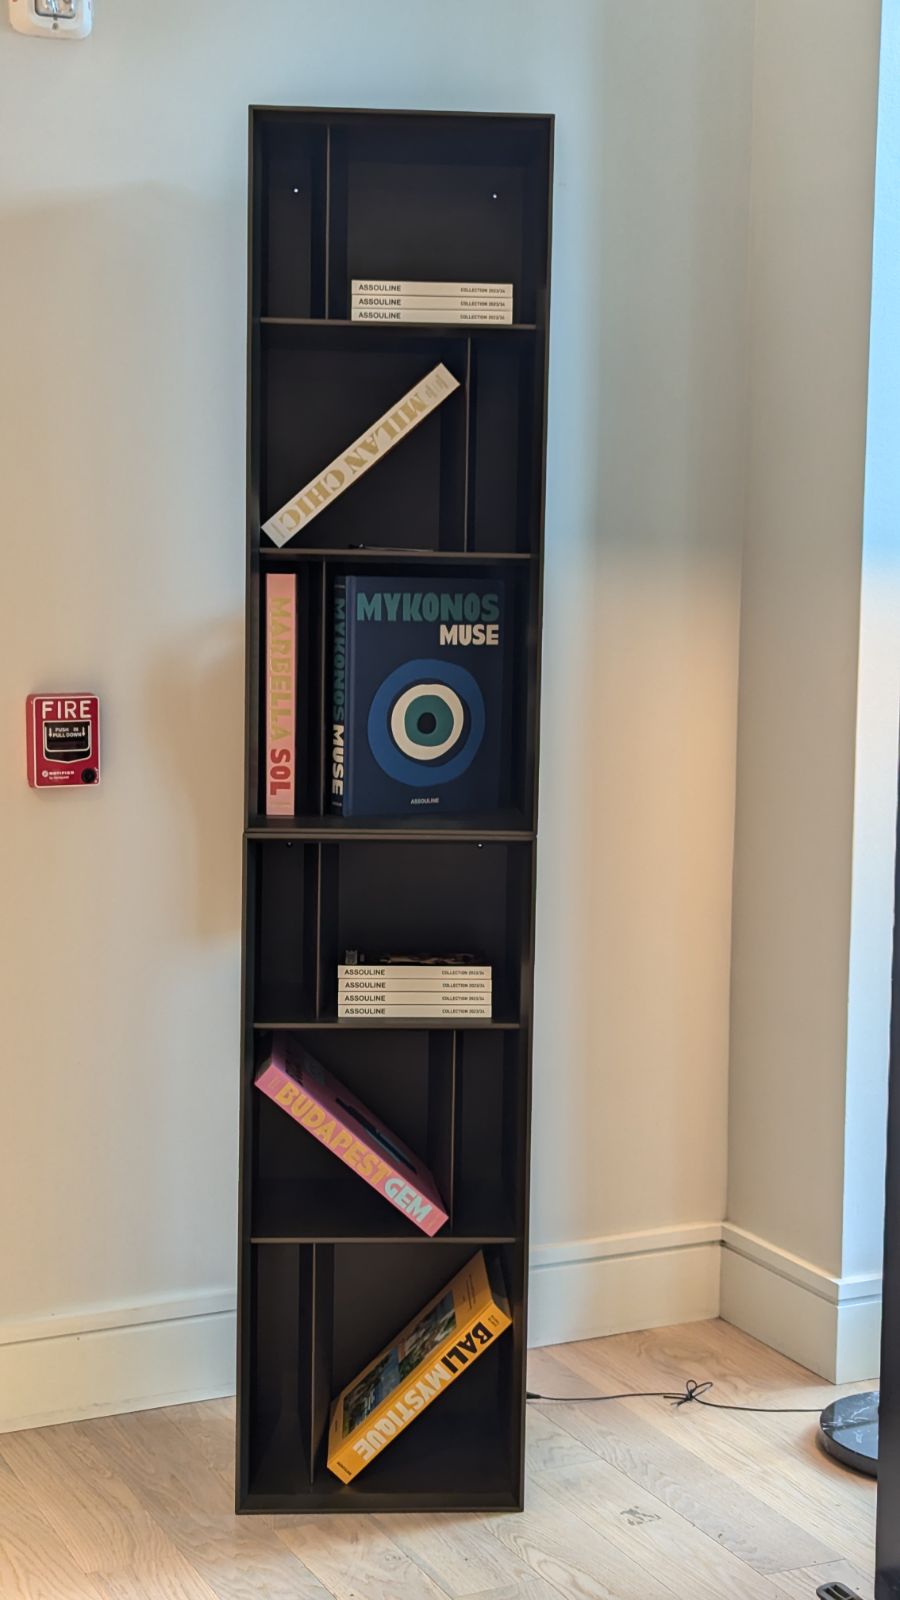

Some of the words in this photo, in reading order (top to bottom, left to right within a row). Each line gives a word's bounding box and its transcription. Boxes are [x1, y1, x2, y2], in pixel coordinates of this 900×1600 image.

[358, 284, 402, 292] ASSOULINE
[358, 298, 402, 306] ASSOULINE
[344, 393, 428, 474] MILAN
[279, 469, 345, 532] CHIC
[357, 592, 500, 622] MYKONOS
[439, 624, 499, 646] MUSE
[270, 597, 292, 741] MARBELLA
[333, 598, 346, 722] MYKONOS
[42, 700, 92, 719] FIRE
[270, 748, 291, 795] SOL
[331, 724, 344, 795] MUSE
[274, 1082, 392, 1185] BUDAPEST
[384, 1177, 433, 1222] GEM
[441, 1322, 493, 1373] BALI
[353, 1363, 452, 1461] MYSTIQUE
